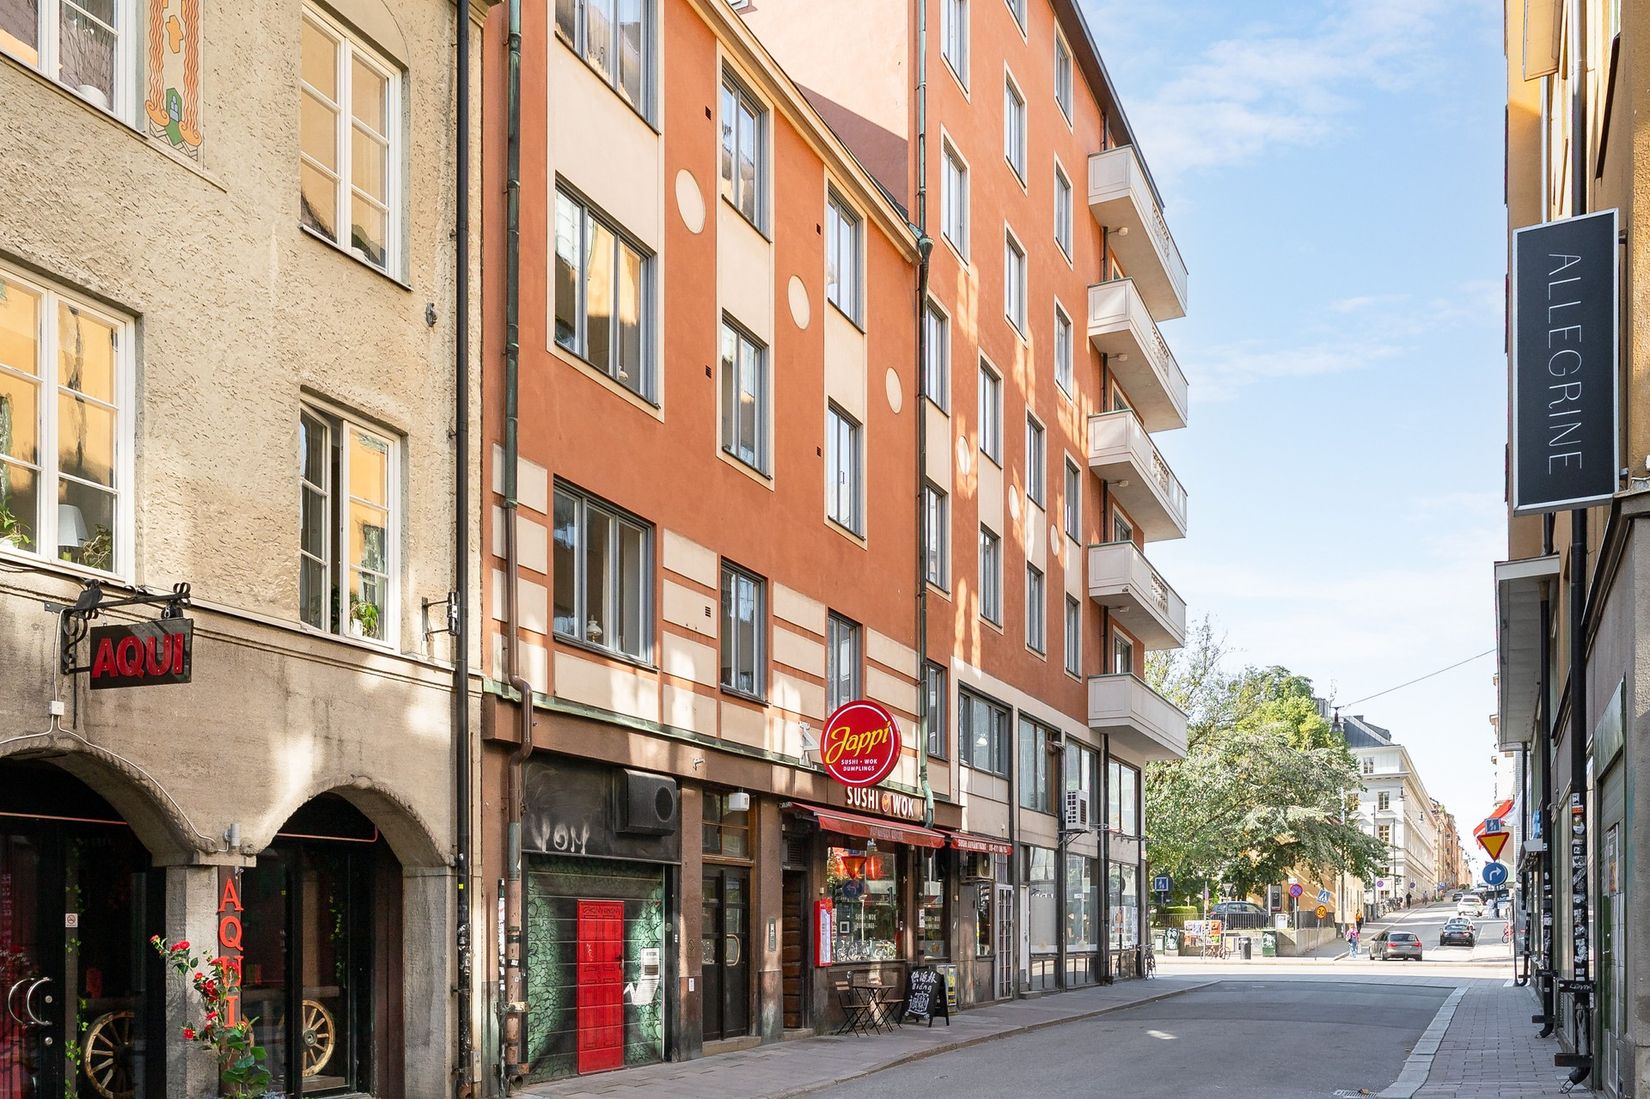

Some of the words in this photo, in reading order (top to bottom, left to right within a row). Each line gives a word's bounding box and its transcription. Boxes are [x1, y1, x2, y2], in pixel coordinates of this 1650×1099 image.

[1548, 253, 1582, 475] ALLEGRINE
[91, 632, 185, 679] AQUI
[826, 720, 891, 764] Jappi
[847, 786, 879, 810] SUSHI
[892, 794, 914, 817] WOK
[218, 879, 245, 1028] AQUI
